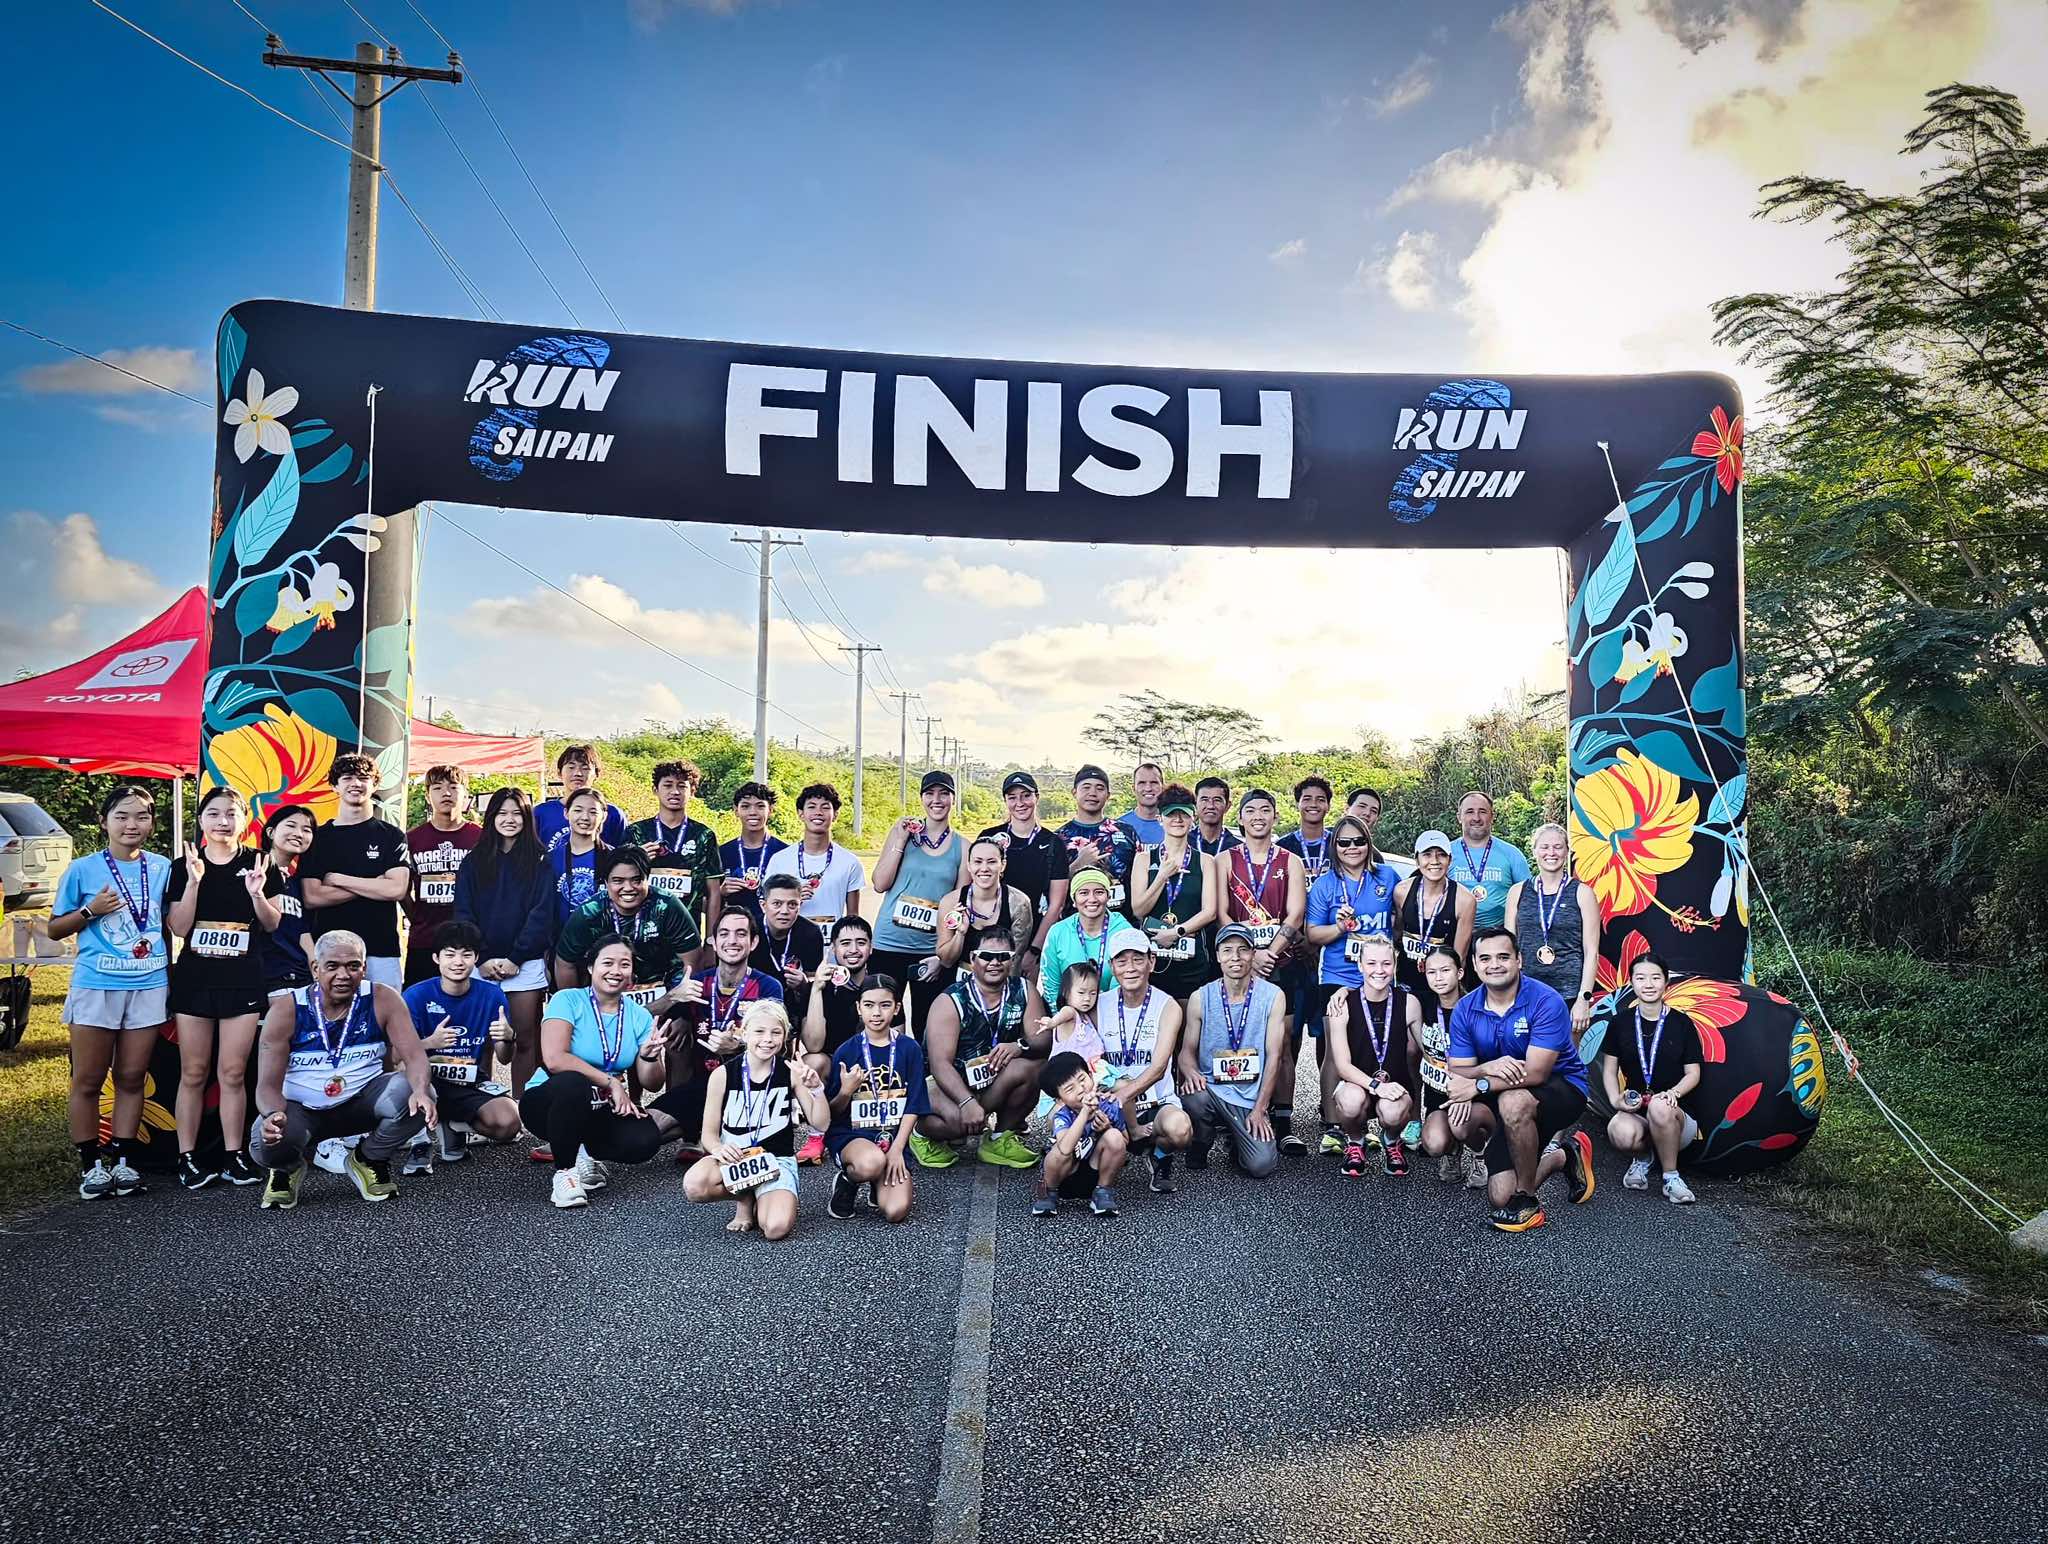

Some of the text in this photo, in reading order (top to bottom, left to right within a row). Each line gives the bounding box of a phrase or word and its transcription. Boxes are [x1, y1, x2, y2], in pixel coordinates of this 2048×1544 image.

[463, 358, 621, 412] RUN
[725, 363, 1294, 499] FINISH
[1392, 407, 1529, 451] RUN
[494, 427, 615, 462] SAIPAN
[1413, 470, 1526, 498] SAIPAN
[43, 692, 162, 703] TOYOTA
[651, 876, 684, 890] 0862
[901, 904, 932, 922] 0870
[199, 931, 240, 948] 0880
[291, 1056, 322, 1066] RUN
[1423, 1062, 1446, 1084] 0887
[723, 1087, 790, 1128] NIKE
[729, 1156, 769, 1182] 0884
